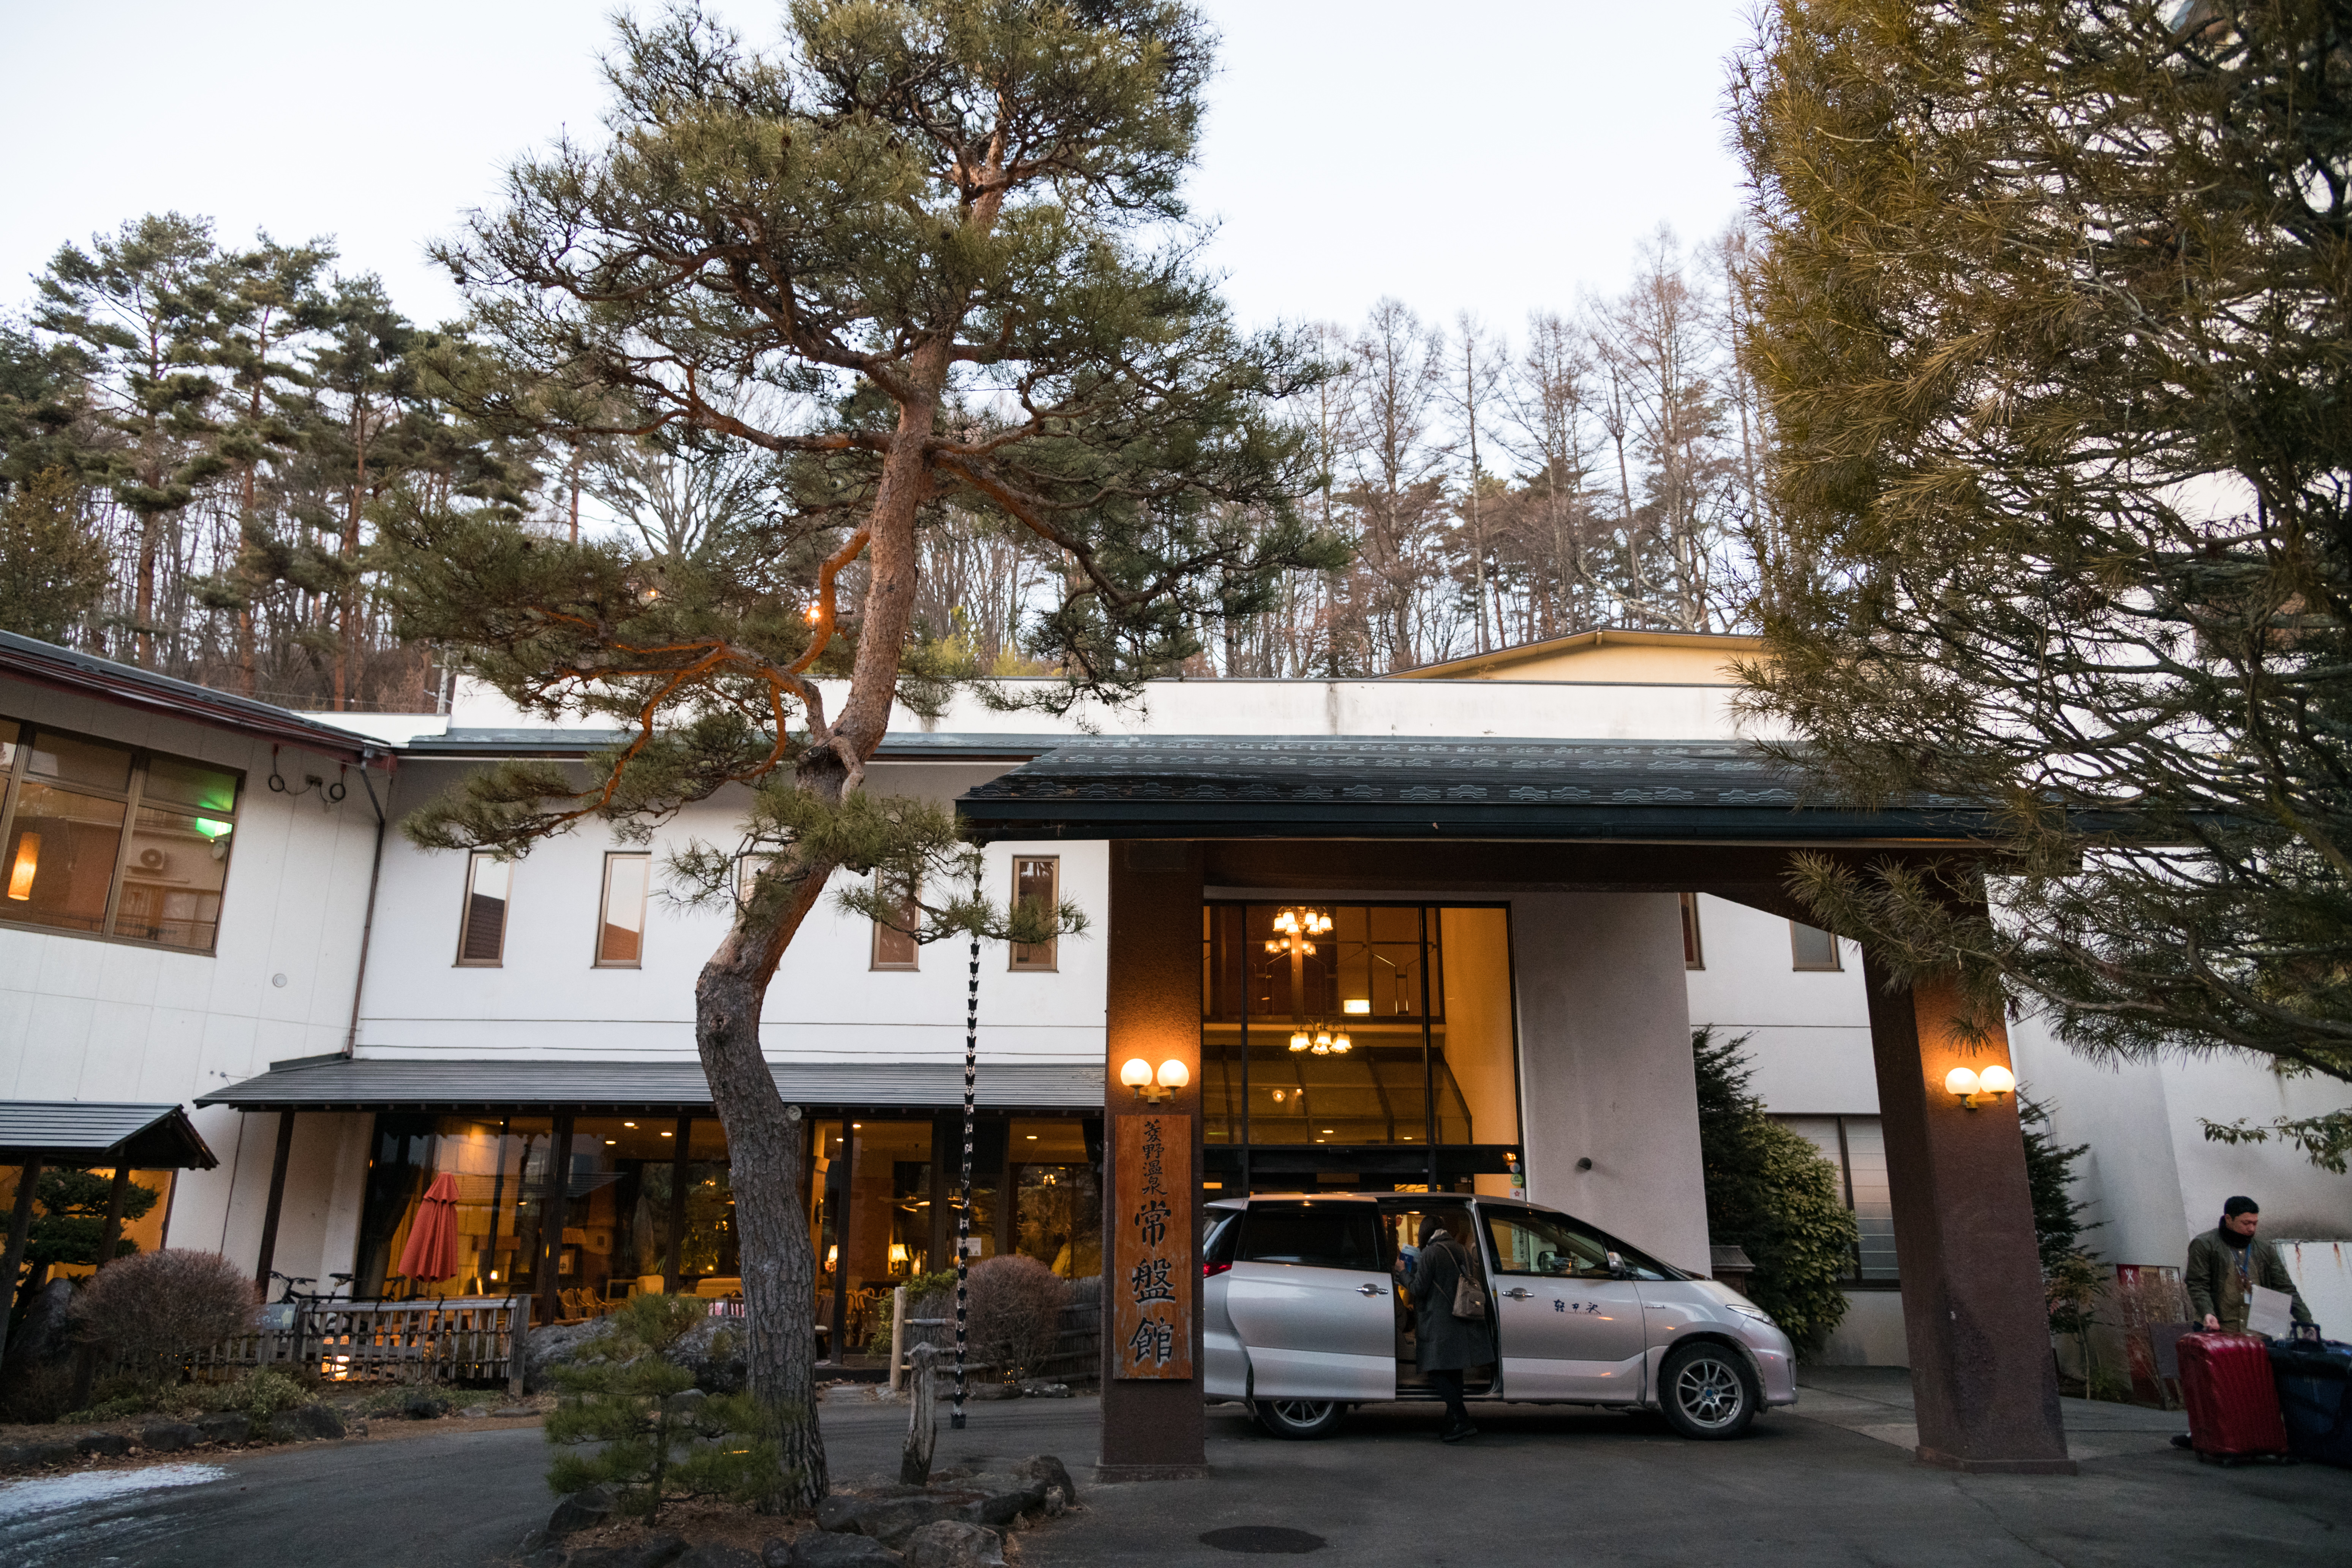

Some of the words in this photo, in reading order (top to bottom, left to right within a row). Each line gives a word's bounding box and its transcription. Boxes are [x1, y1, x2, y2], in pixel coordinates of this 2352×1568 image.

[1142, 1119, 1168, 1195] 菱野温泉
[1129, 1200, 1176, 1364] 常盤館
